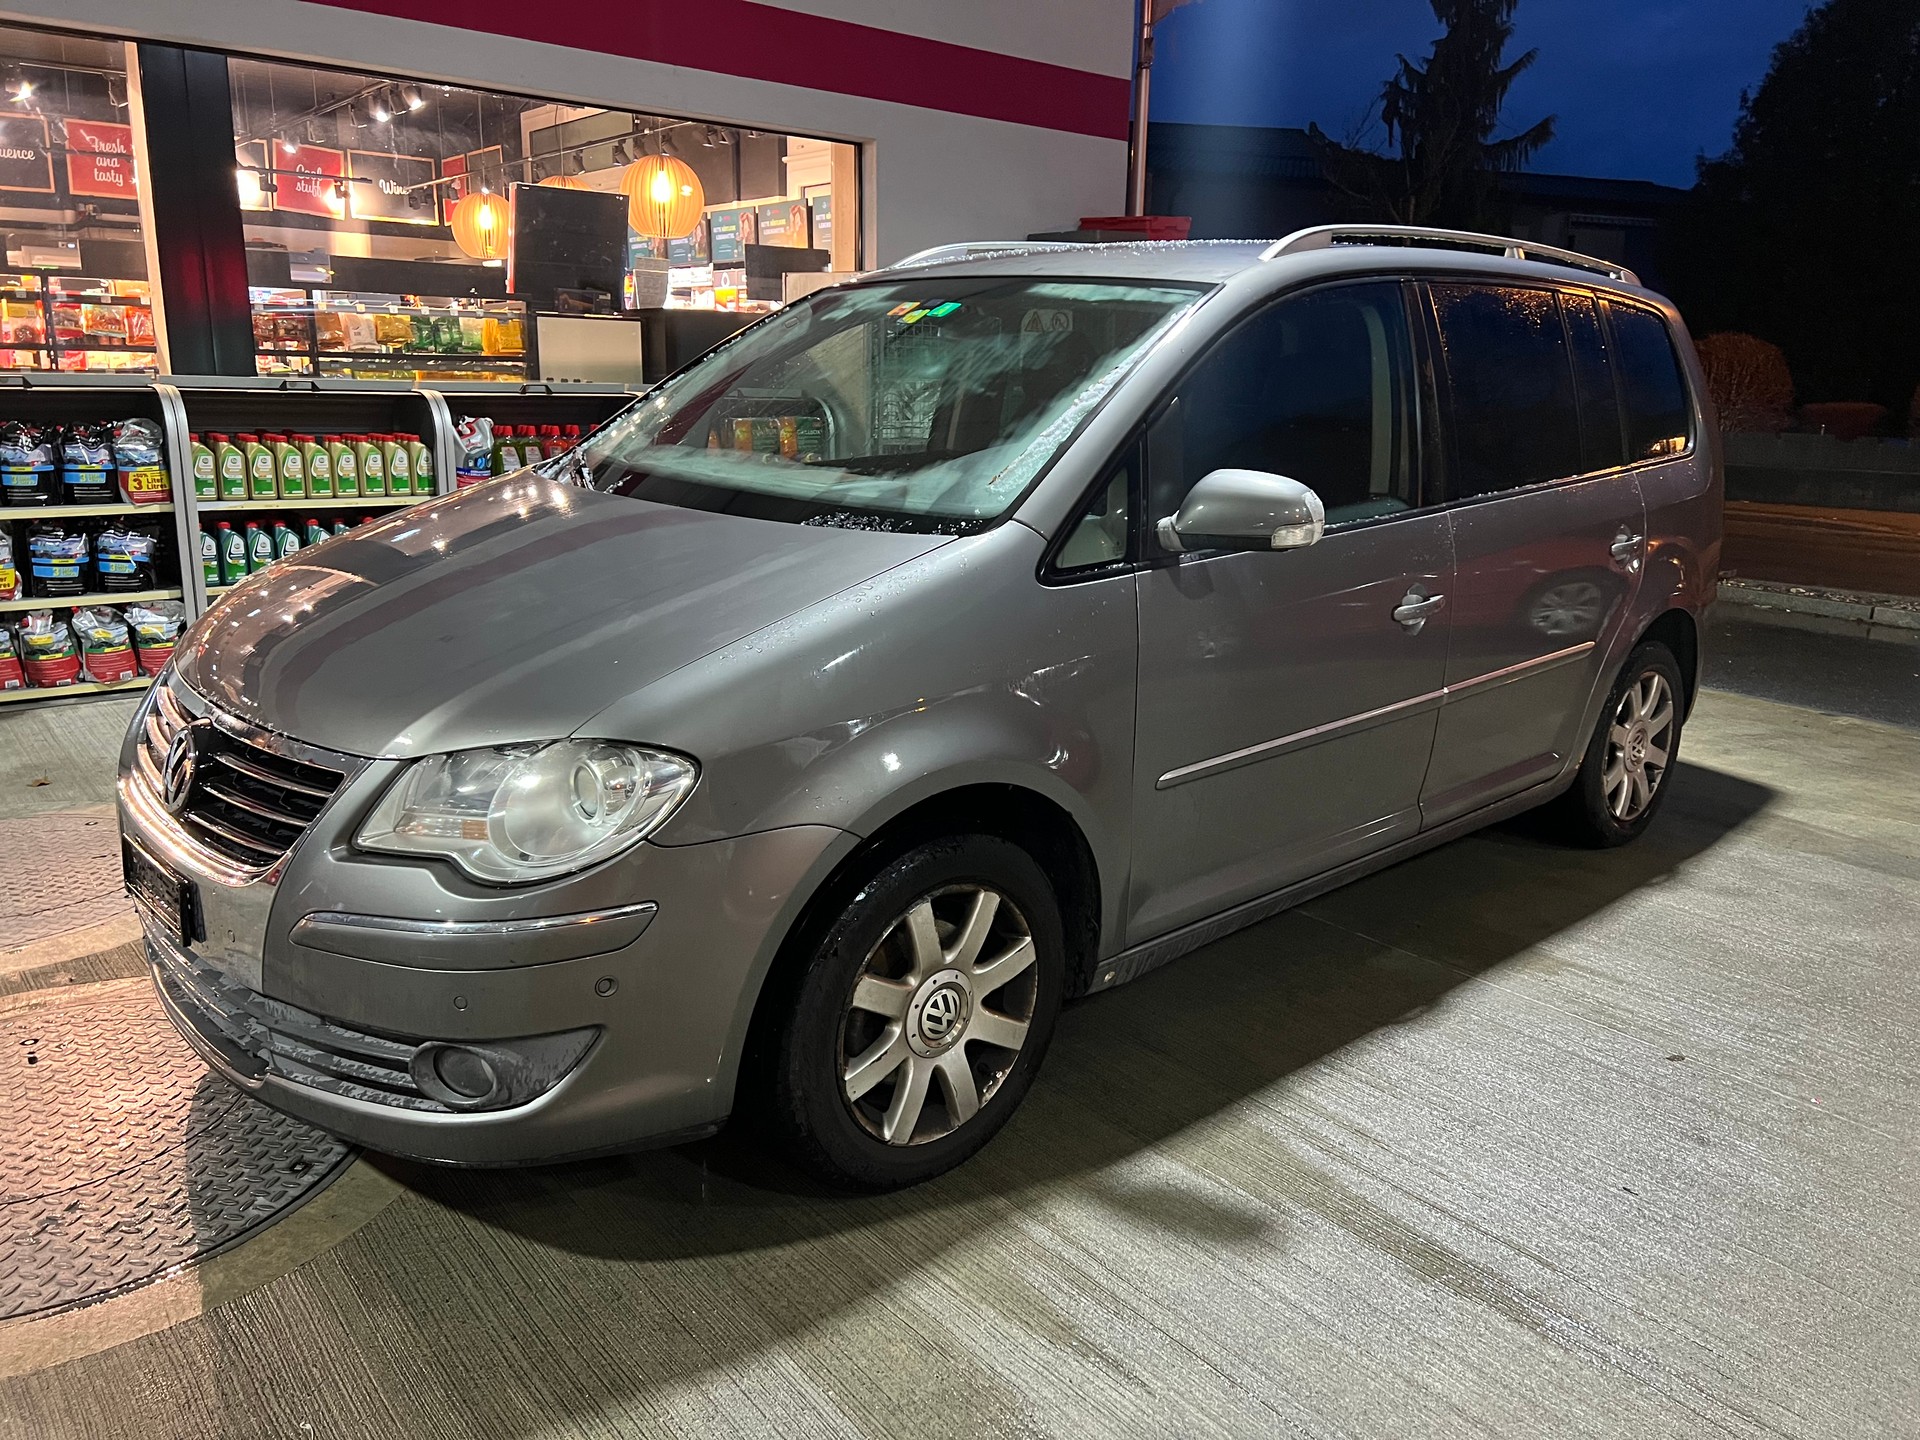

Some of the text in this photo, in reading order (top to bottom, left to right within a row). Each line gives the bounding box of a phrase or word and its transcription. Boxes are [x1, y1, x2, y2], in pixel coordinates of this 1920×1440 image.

[88, 136, 126, 153] Fresh
[96, 156, 120, 167] and
[94, 168, 123, 186] tasty
[296, 180, 321, 197] stuff
[133, 477, 143, 490] 3
[921, 988, 961, 1040] VW
